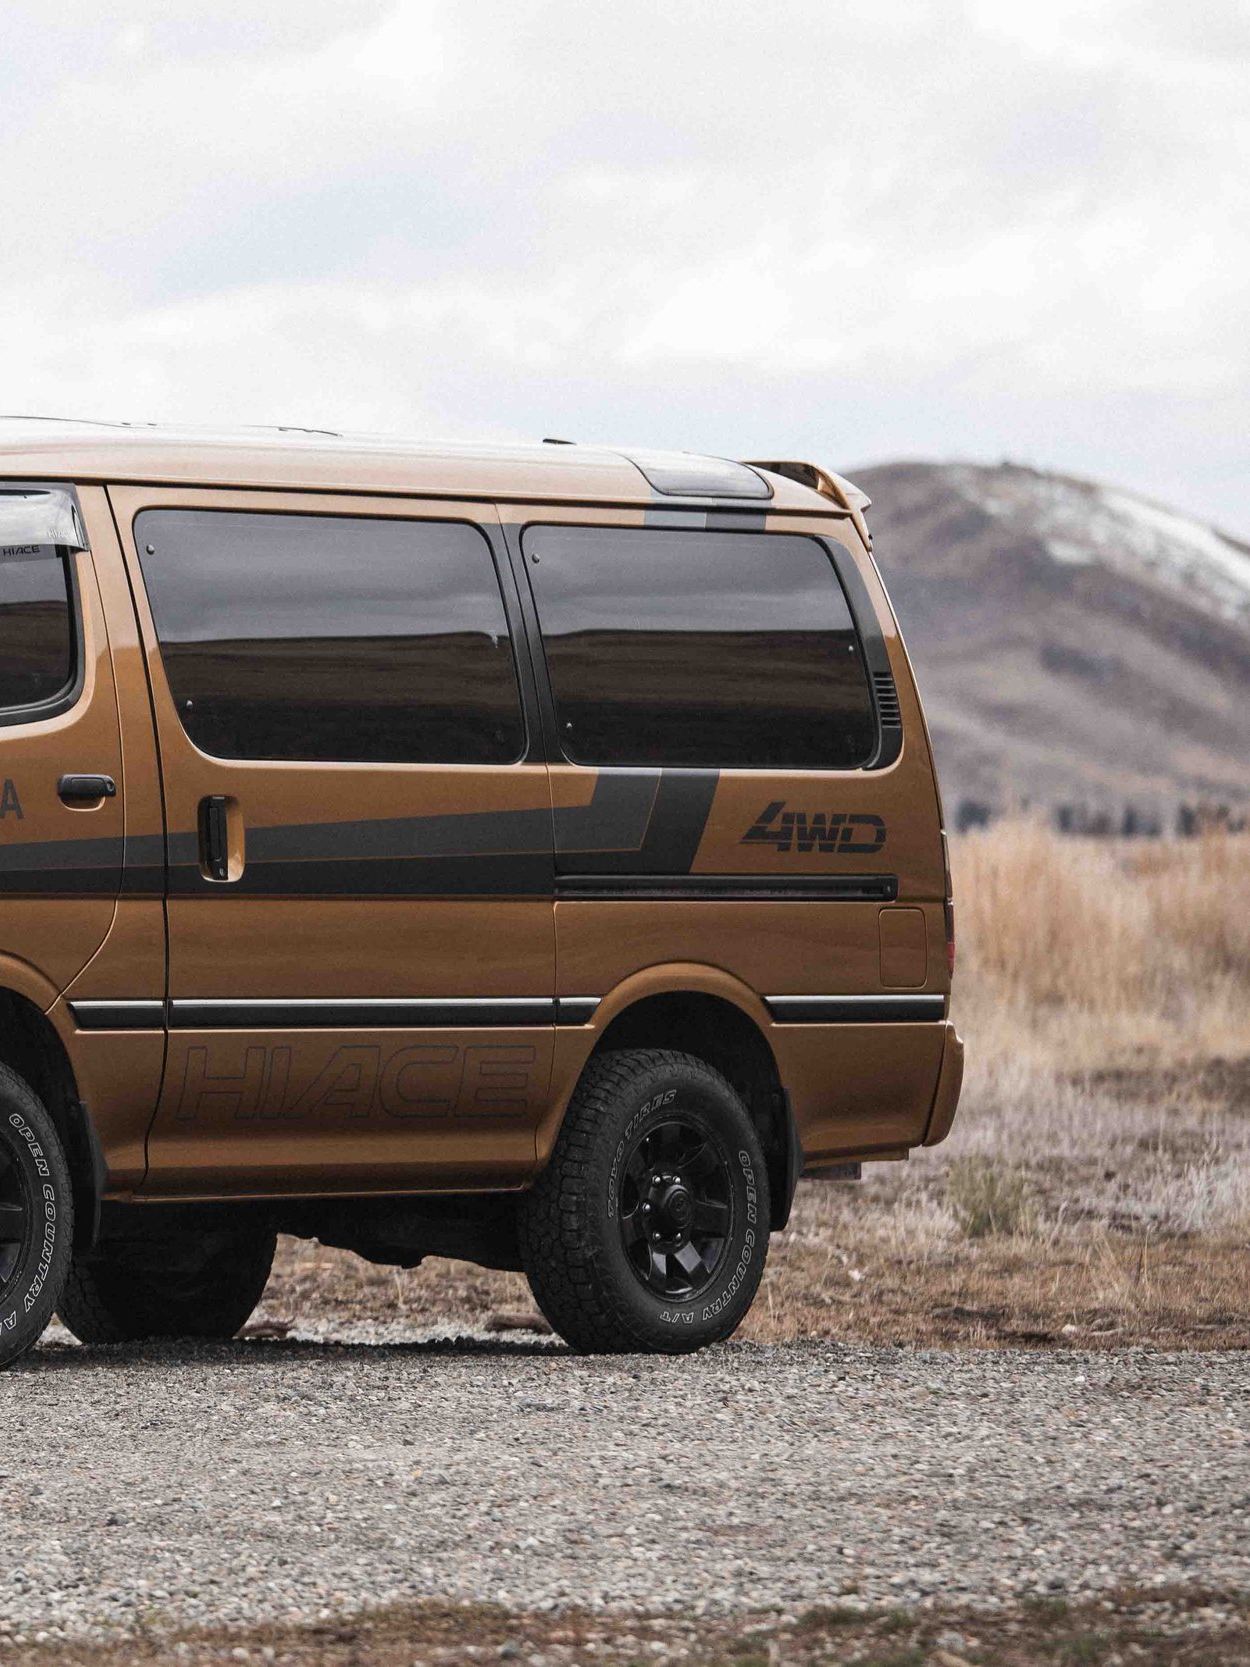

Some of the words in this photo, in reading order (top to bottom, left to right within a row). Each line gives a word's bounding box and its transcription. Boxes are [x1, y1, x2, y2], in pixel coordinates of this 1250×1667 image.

[3, 545, 40, 556] HIACE
[740, 801, 886, 853] 4WD
[176, 1045, 535, 1119] HIACE
[8, 1113, 50, 1177] OPEN
[607, 1140, 625, 1218] TOYO
[738, 1150, 758, 1224] OPEN
[23, 1184, 56, 1313] COUNTRY
[702, 1228, 755, 1321] COUNTRY
[660, 1311, 695, 1324] A/T
